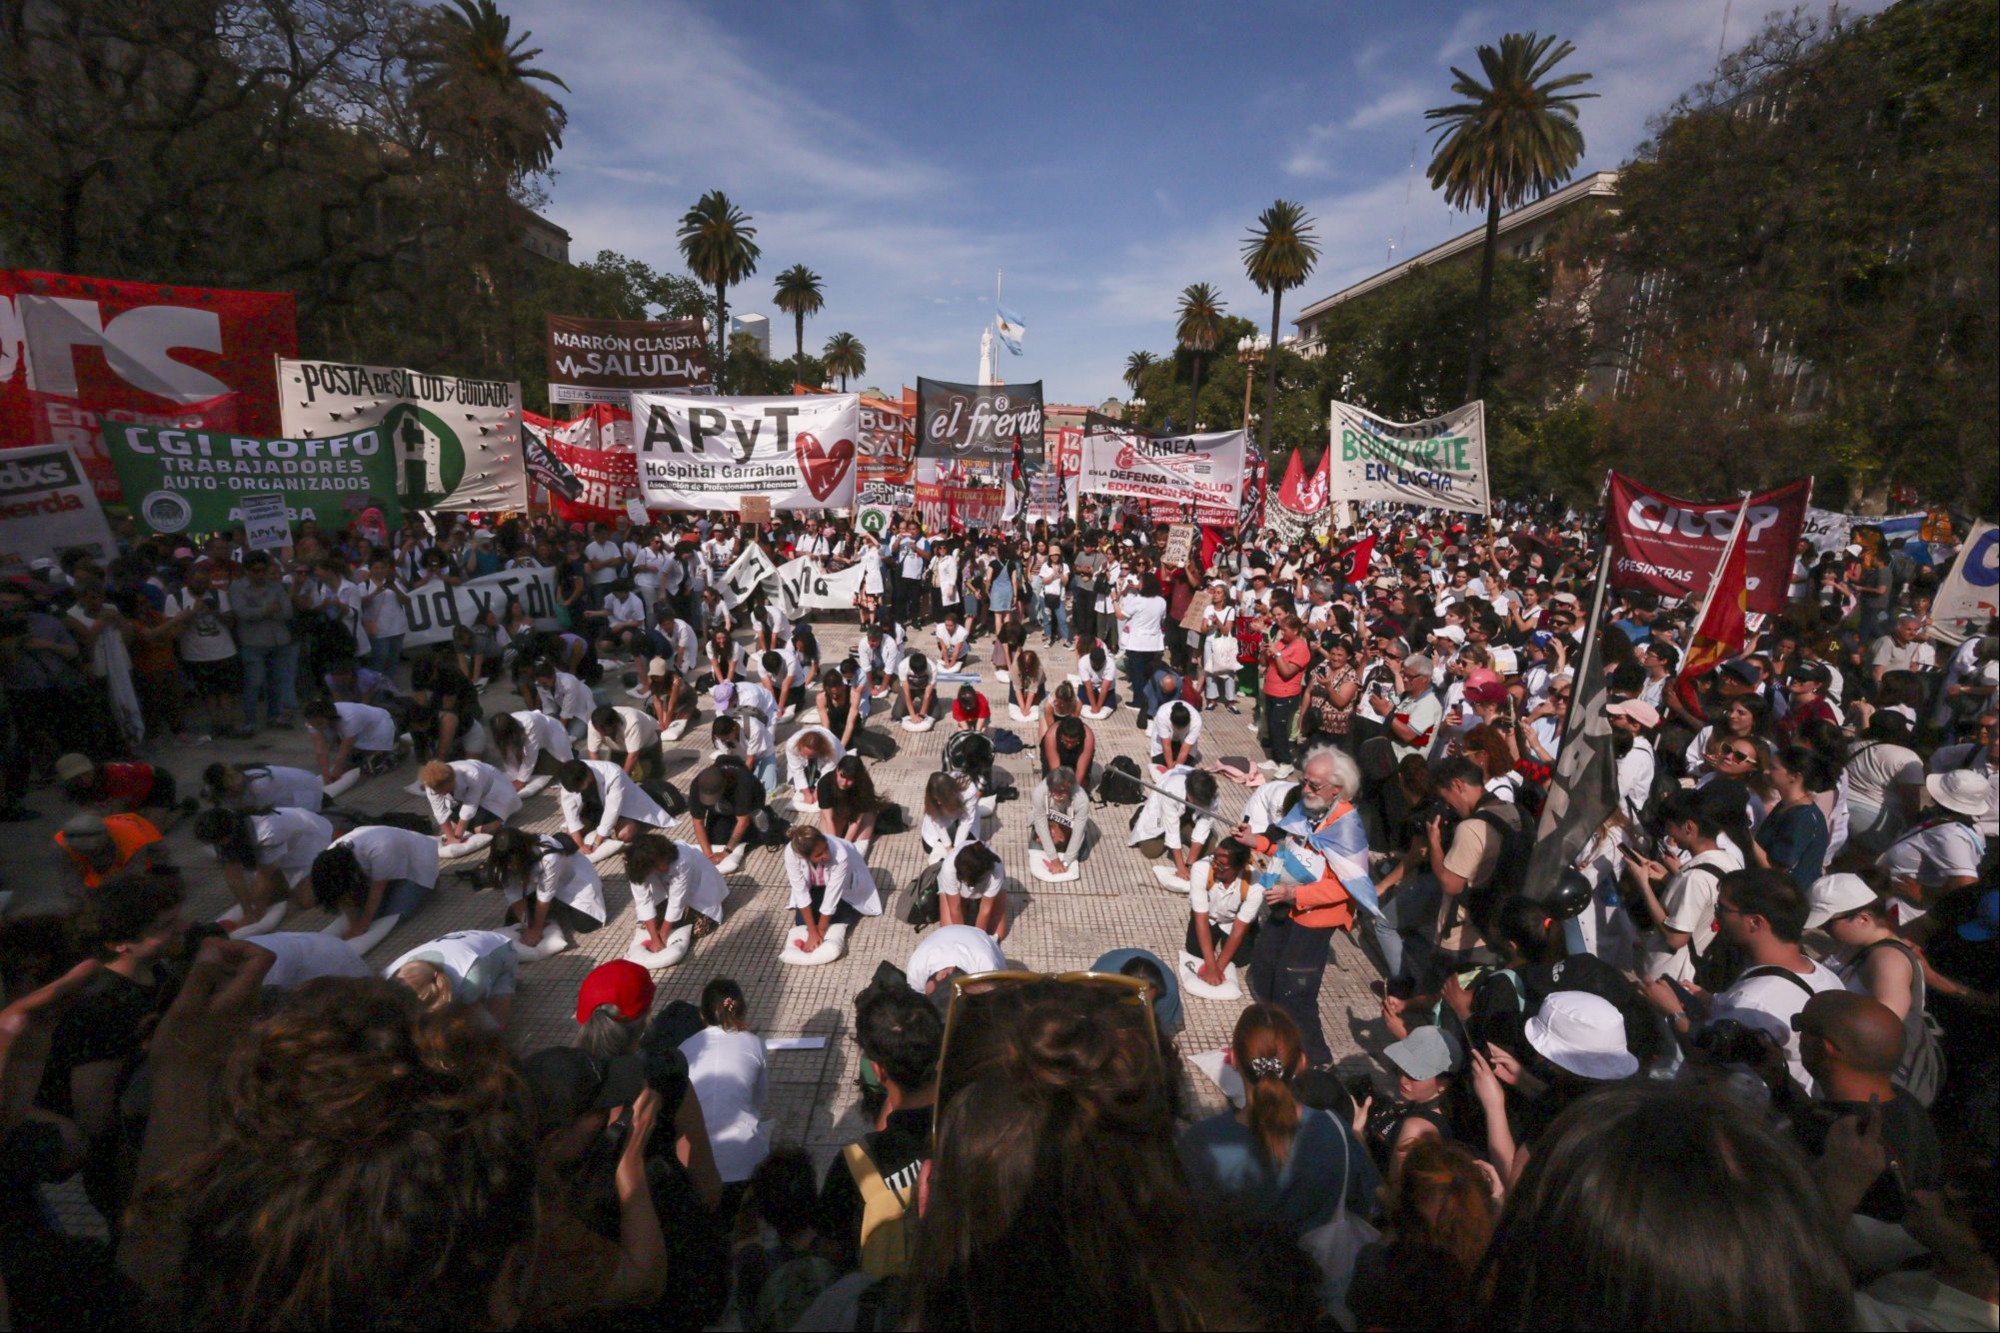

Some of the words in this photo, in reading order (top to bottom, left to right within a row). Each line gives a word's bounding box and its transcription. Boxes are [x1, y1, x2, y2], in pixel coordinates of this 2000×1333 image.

[553, 331, 631, 351] MARRÓN
[634, 335, 701, 352] CLASISTA
[587, 353, 679, 377] SALUD
[301, 363, 375, 402] POSTA
[373, 373, 392, 394] DE
[391, 369, 444, 402] SALUD
[584, 391, 592, 400] 5
[643, 404, 800, 464] APyT
[931, 402, 963, 438] el
[955, 403, 1041, 448] frente
[125, 427, 212, 456] CGI
[230, 431, 380, 458] ROFFO
[1136, 438, 1197, 457] MAREA
[160, 457, 364, 474] TRABAJADORES
[573, 463, 640, 484] Democrac
[646, 462, 716, 480] Hospital
[721, 464, 796, 478] Garrahan
[1365, 463, 1389, 481] EN
[1397, 467, 1453, 490] LUCHA
[163, 476, 371, 491] AUTO-ORGANIZADOS
[703, 483, 755, 491] Profesionales
[762, 480, 797, 489] Técnicos
[1108, 481, 1177, 498] EDUCACIÓN
[1179, 490, 1228, 505] PÚBLICA
[1110, 469, 1168, 485] DEFENSA
[1193, 481, 1233, 494] SALUD
[1628, 496, 1779, 542] CICOP
[1623, 560, 1694, 582] FESINTRAS
